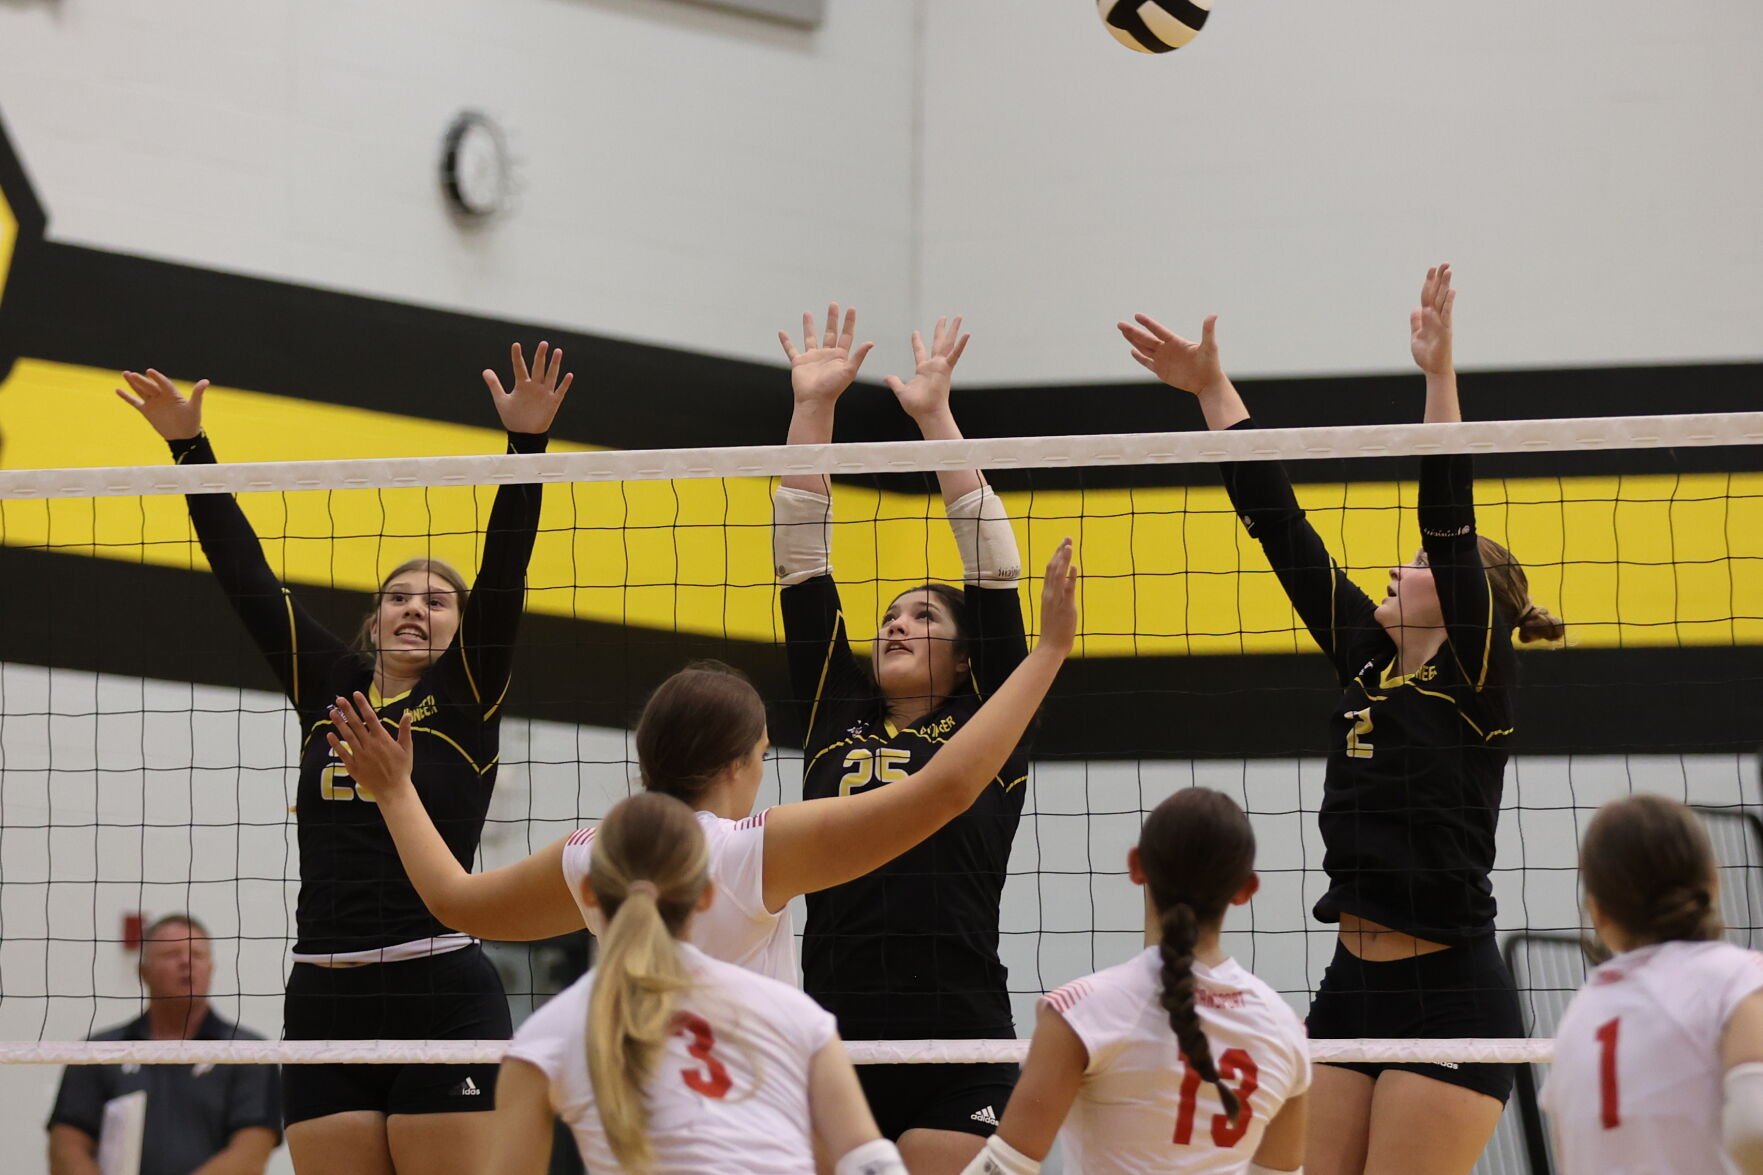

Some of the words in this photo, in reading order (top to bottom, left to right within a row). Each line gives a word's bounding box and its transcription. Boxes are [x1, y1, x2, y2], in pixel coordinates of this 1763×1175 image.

[1343, 706, 1374, 759] 2
[320, 740, 378, 803] 2
[838, 747, 911, 797] 25
[665, 1010, 734, 1100] 3
[1595, 1016, 1621, 1131] 1
[970, 1113, 999, 1127] adidas
[1173, 1047, 1259, 1148] 13
